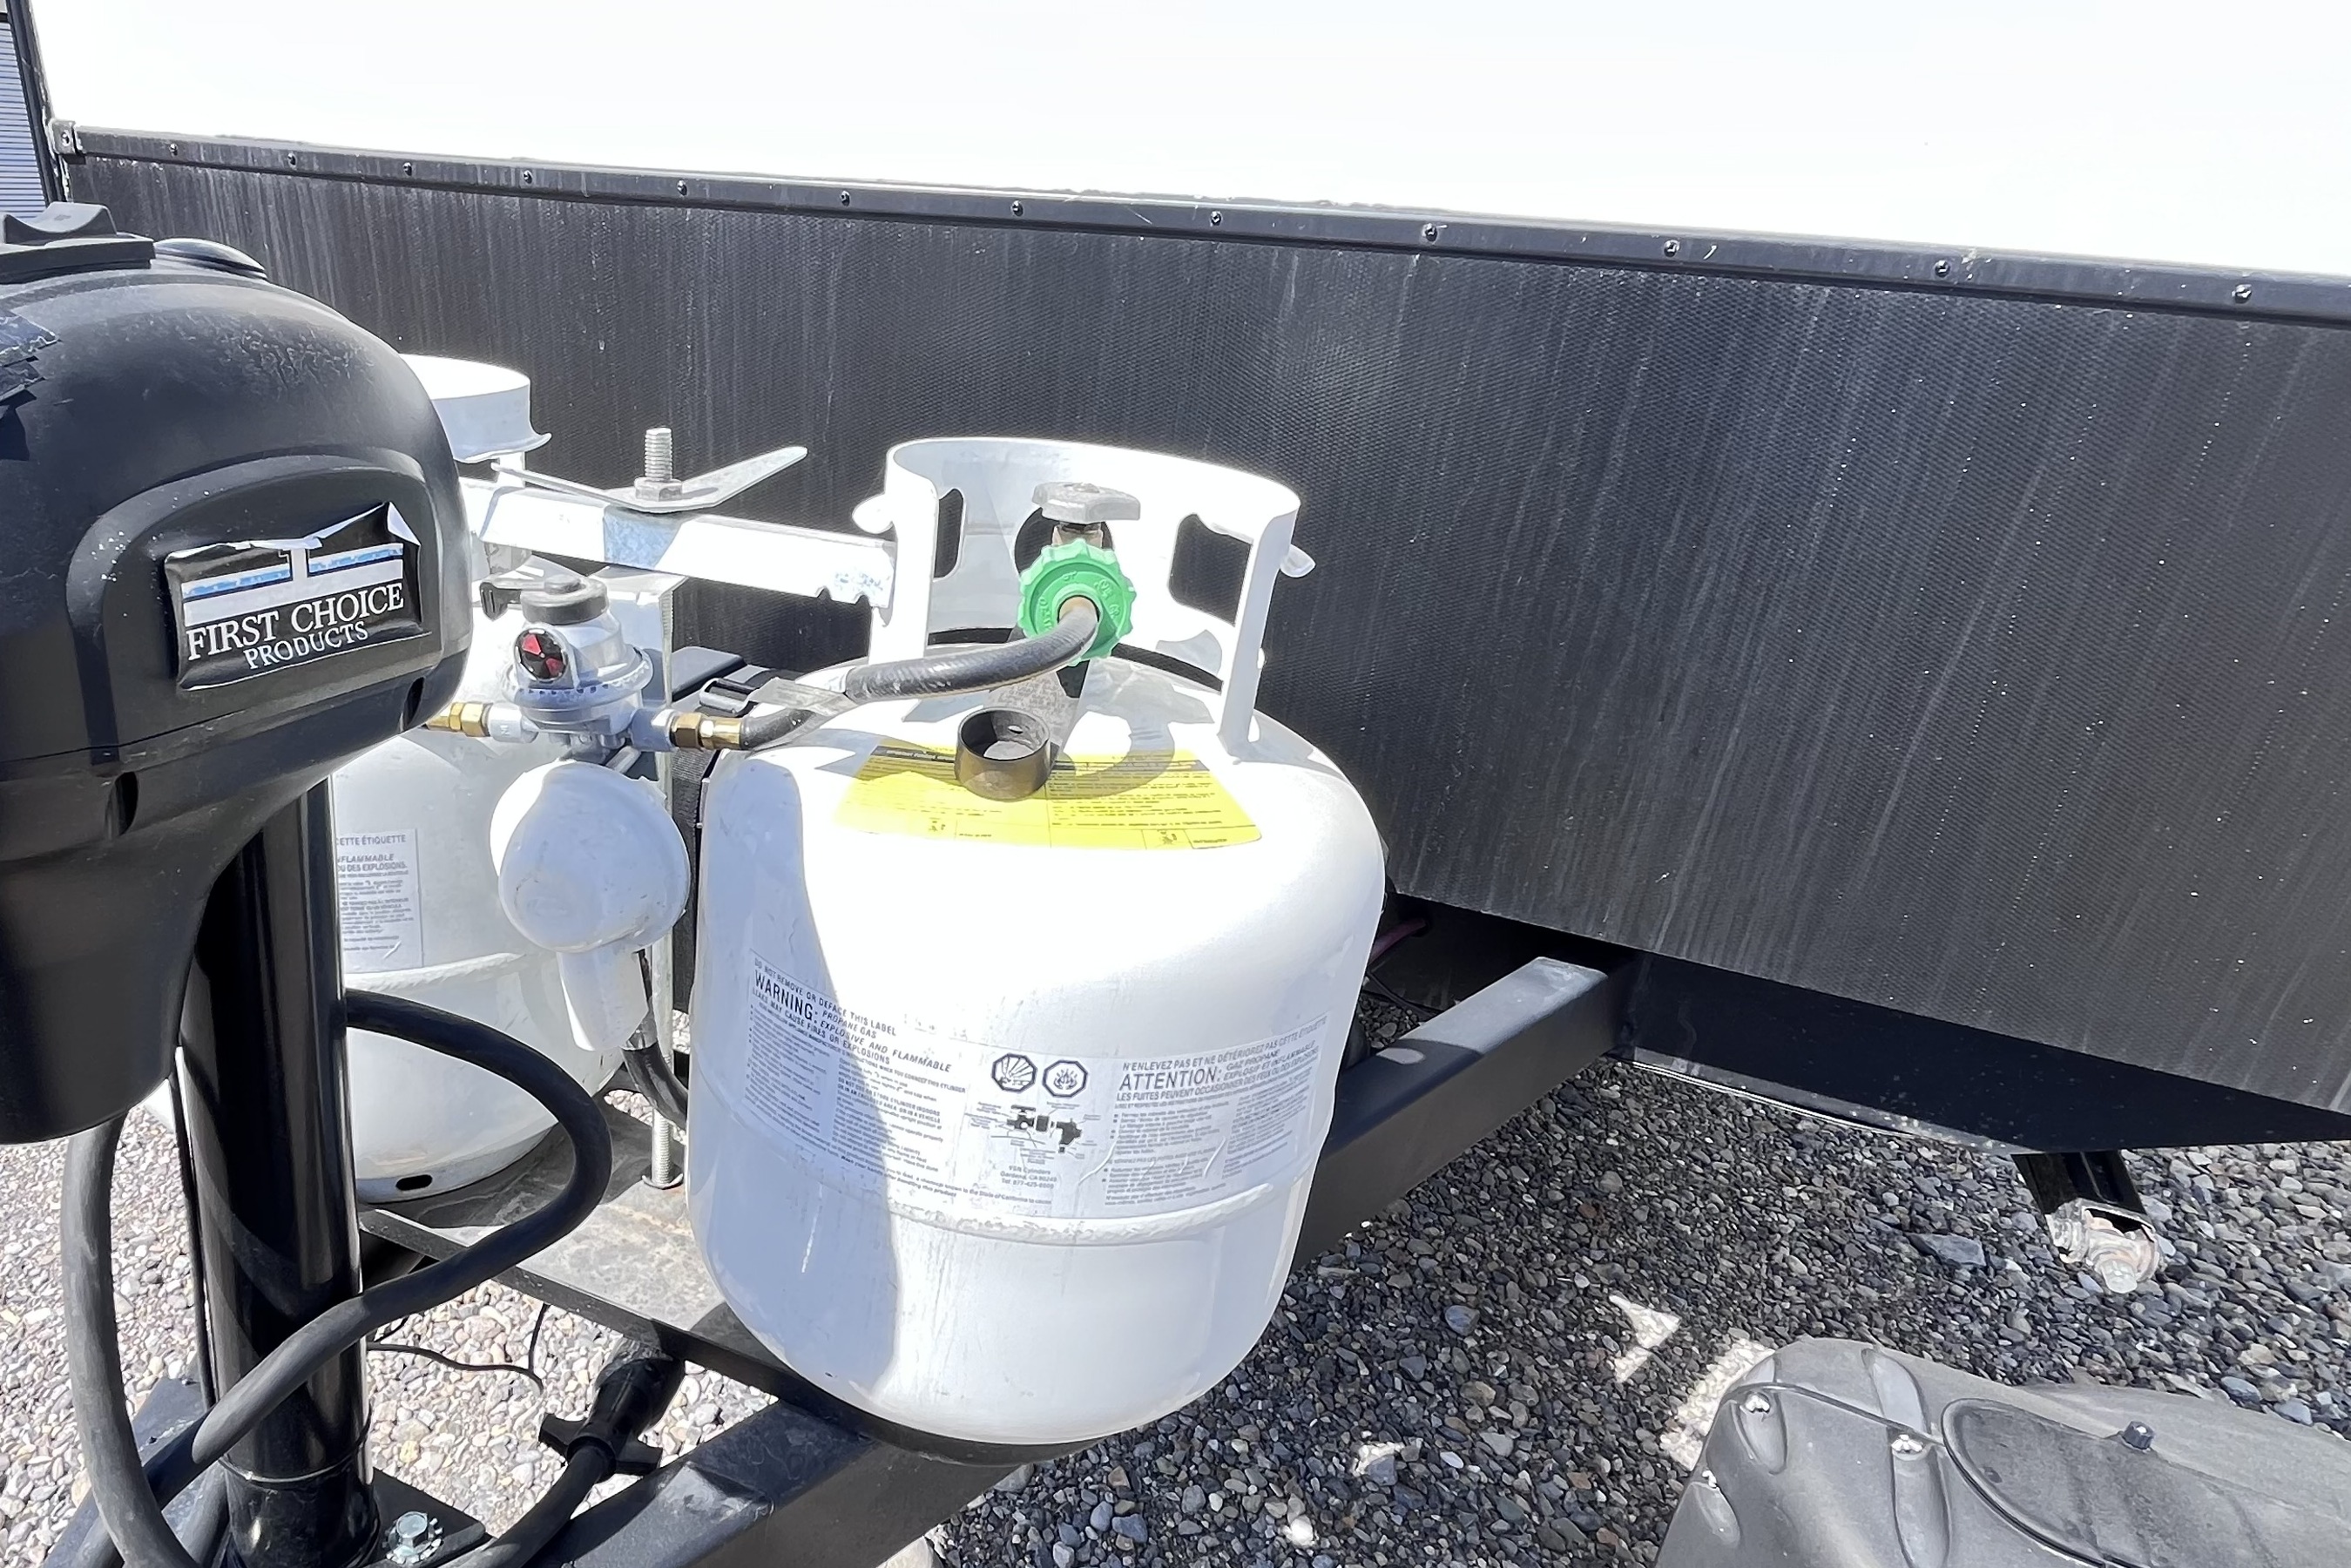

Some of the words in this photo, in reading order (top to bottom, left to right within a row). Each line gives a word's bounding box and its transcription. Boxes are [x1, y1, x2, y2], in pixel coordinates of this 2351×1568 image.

[186, 611, 279, 661] FIRST
[291, 583, 404, 633] CHOICE
[243, 620, 369, 670] PRODUCTS
[361, 835, 407, 845] ÉTIQUETTE
[777, 974, 803, 997] REMOVE
[806, 991, 817, 1003] OR
[819, 997, 847, 1017] DEFACE
[849, 1010, 868, 1026] THIS
[870, 1019, 897, 1037] LABEL
[822, 1009, 859, 1031] PROPANE
[860, 1026, 878, 1039] GAS
[770, 1000, 782, 1012] MAY
[784, 1010, 805, 1028] CAUSE
[807, 1021, 826, 1038] FIRES
[829, 1033, 840, 1045] OR
[842, 1039, 890, 1064] EXPLOSIONS
[820, 1019, 865, 1045] EXPLOSIVE
[868, 1040, 888, 1054] AND
[892, 1048, 953, 1073] FLAMMABLE
[1122, 1059, 1173, 1071] N'ENLEVEZ
[1172, 1058, 1192, 1070] PAS
[1192, 1057, 1204, 1067] ET
[1204, 1054, 1216, 1065] NE
[1265, 1040, 1278, 1051] PAS
[1226, 1059, 1244, 1071] GAZ
[1117, 1092, 1132, 1101] LES
[1132, 1092, 1159, 1101] FUITES
[1160, 1087, 1195, 1099] PEUVENT
